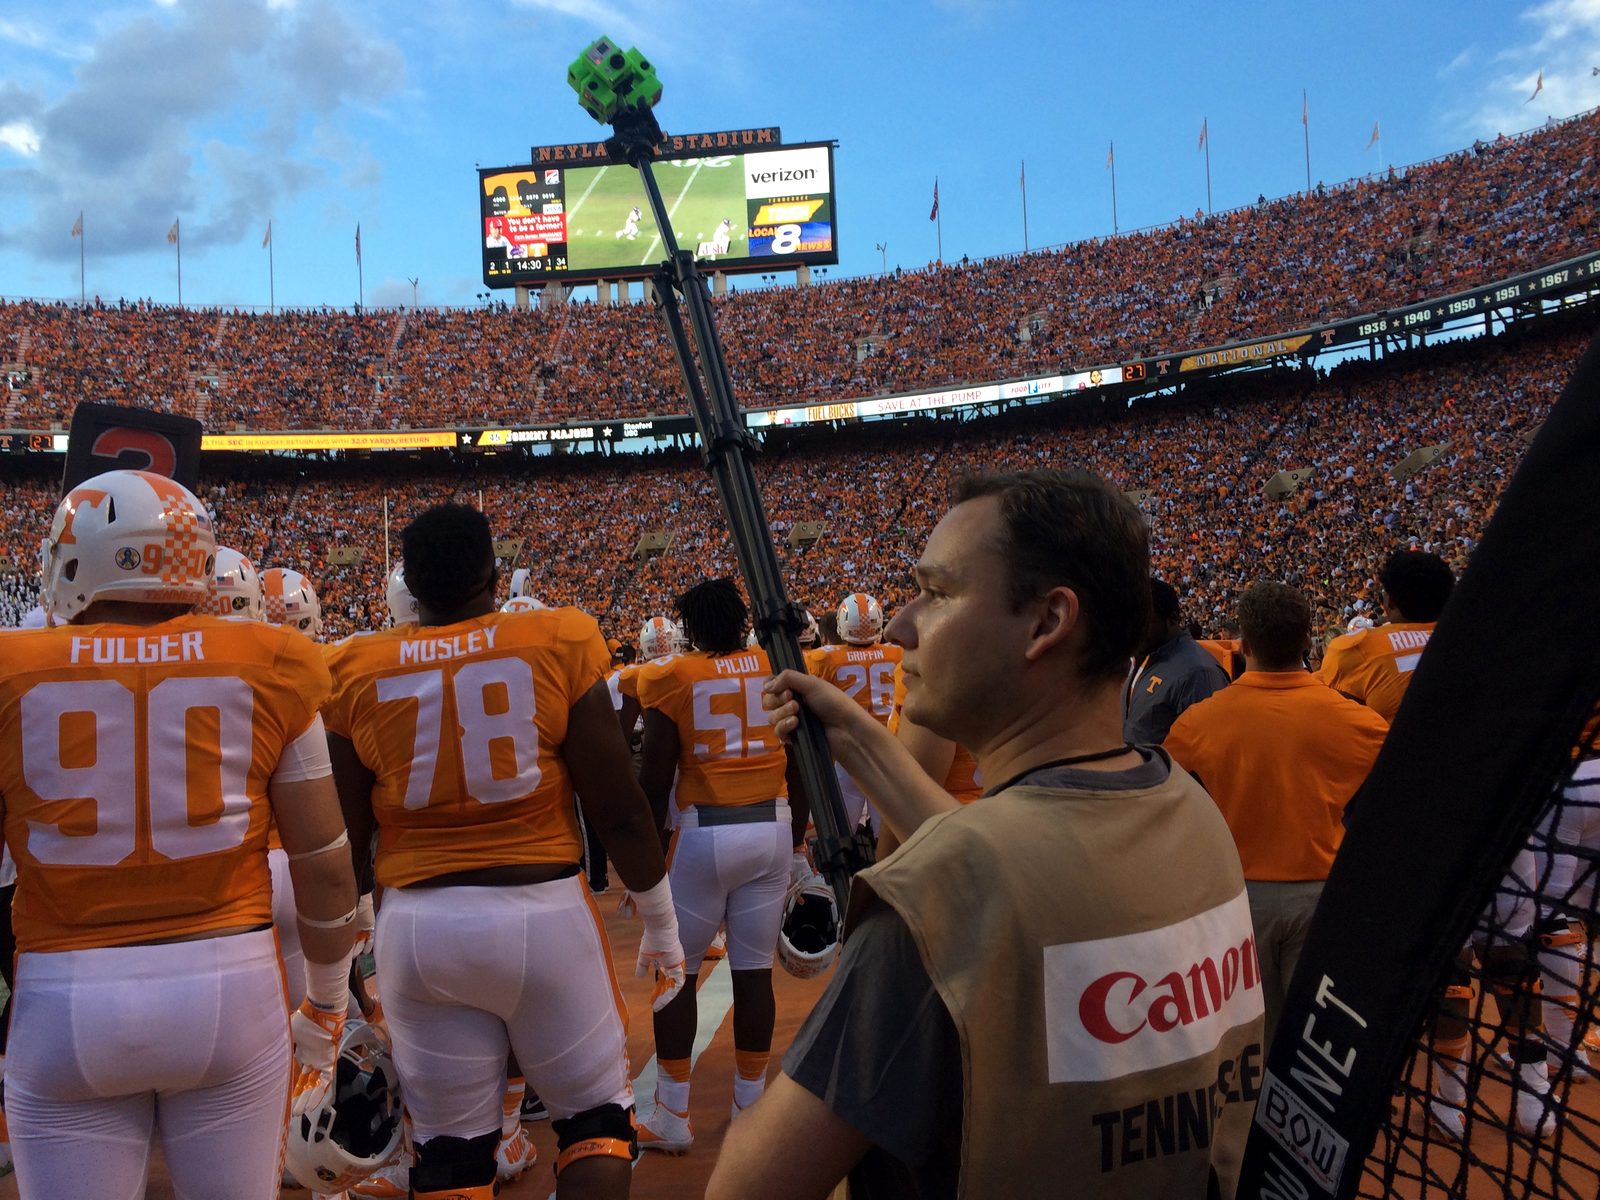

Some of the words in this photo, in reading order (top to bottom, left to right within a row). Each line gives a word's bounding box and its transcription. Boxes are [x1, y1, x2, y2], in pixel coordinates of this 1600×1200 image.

[539, 142, 607, 161] NEYLA
[673, 129, 772, 150] STADIUM
[752, 168, 814, 183] verizon
[772, 224, 802, 254] 8
[517, 260, 542, 270] 14:30
[1358, 320, 1387, 336] 1938
[1404, 310, 1431, 326] 1940
[1448, 298, 1476, 315] 1950
[1495, 285, 1520, 302] 1951
[1540, 270, 1569, 288] 1967
[1195, 341, 1287, 367] NATIONAL
[1126, 364, 1143, 379] 27
[808, 407, 826, 421] FUEL
[828, 404, 855, 420] BUCKS
[878, 401, 907, 412] SAVE
[909, 398, 926, 410] AT
[928, 394, 950, 406] THE
[951, 390, 982, 404] PUMP
[33, 435, 52, 448] 27
[506, 430, 548, 442] JOHNNY
[550, 428, 594, 440] MAJORS
[70, 631, 204, 664] FULGER
[847, 649, 884, 662] GRIFFIN
[376, 656, 542, 811] 78
[20, 676, 254, 866] 90
[1079, 932, 1262, 1044] Canon
[1289, 974, 1368, 1113] NET
[1265, 1086, 1338, 1176] BOW
